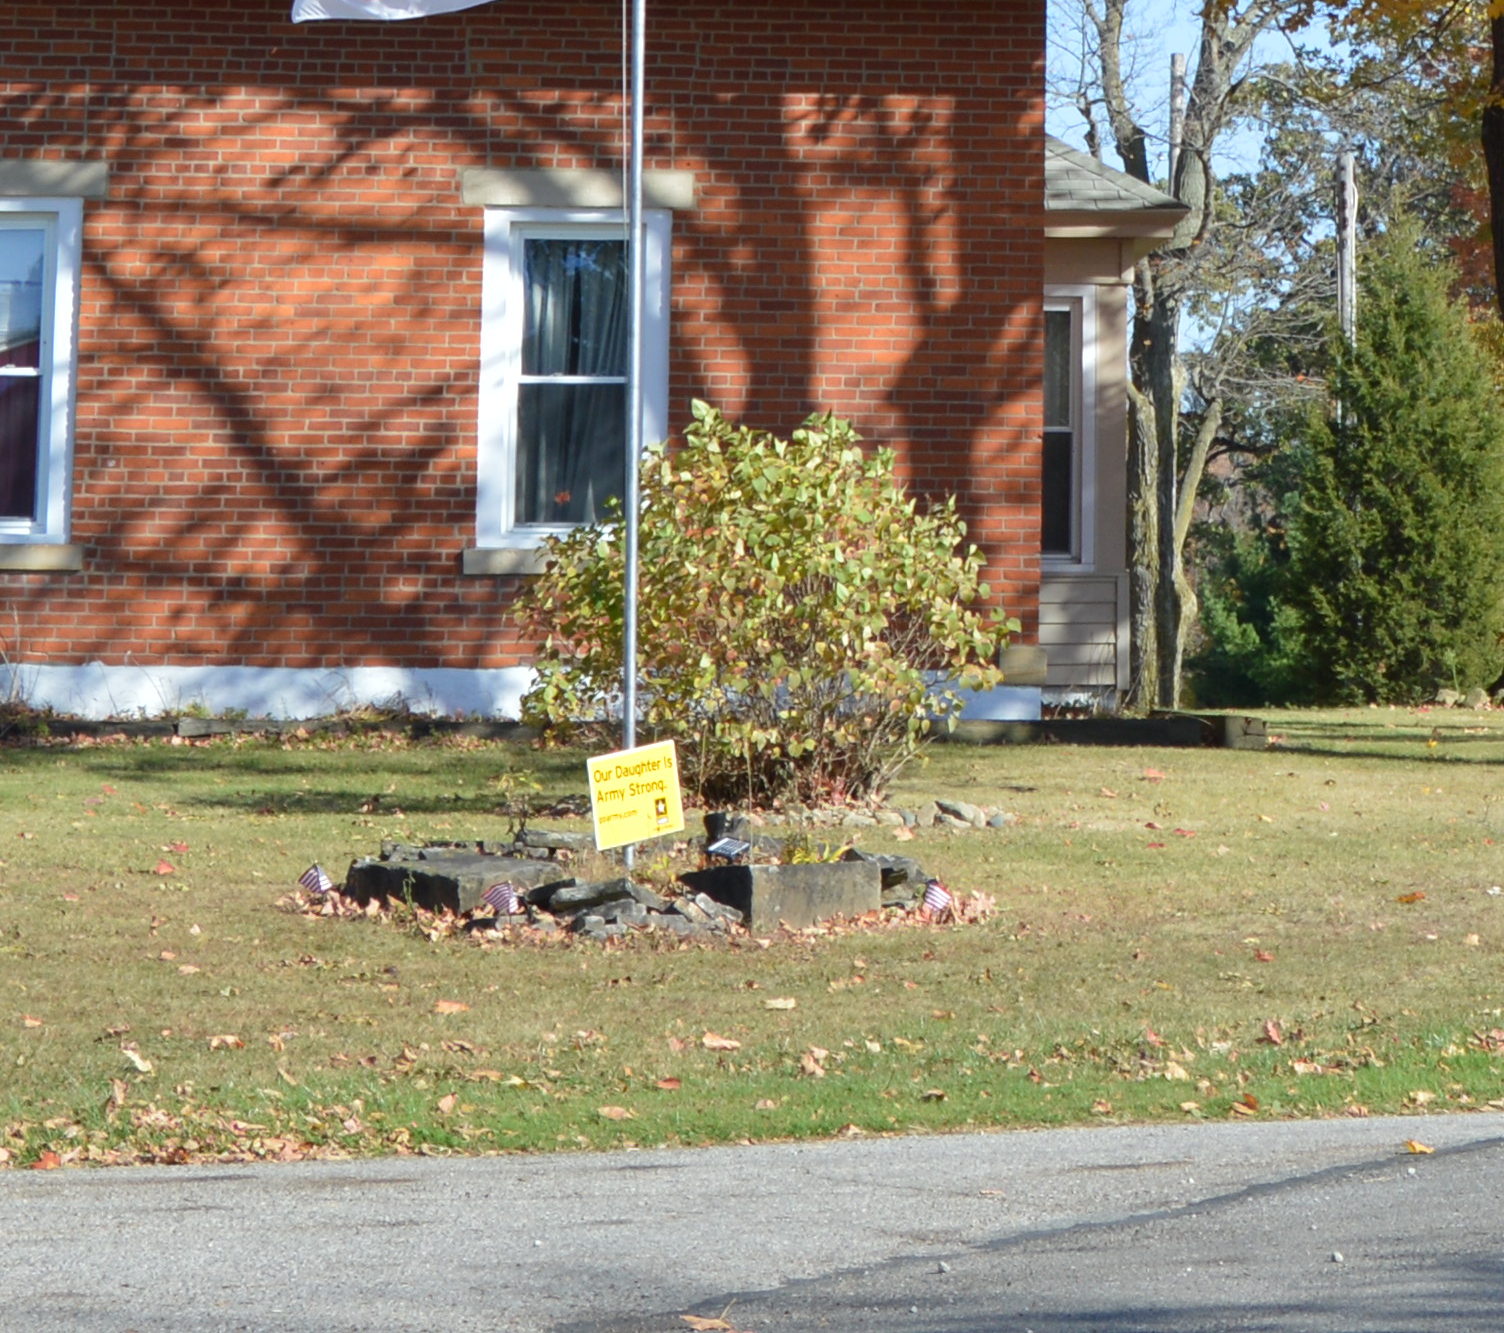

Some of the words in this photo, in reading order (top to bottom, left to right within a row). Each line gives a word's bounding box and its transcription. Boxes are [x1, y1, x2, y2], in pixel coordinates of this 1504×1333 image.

[594, 769, 612, 783] Our
[615, 759, 661, 779] Daughter
[664, 756, 673, 769] Is
[597, 788, 626, 804] Army
